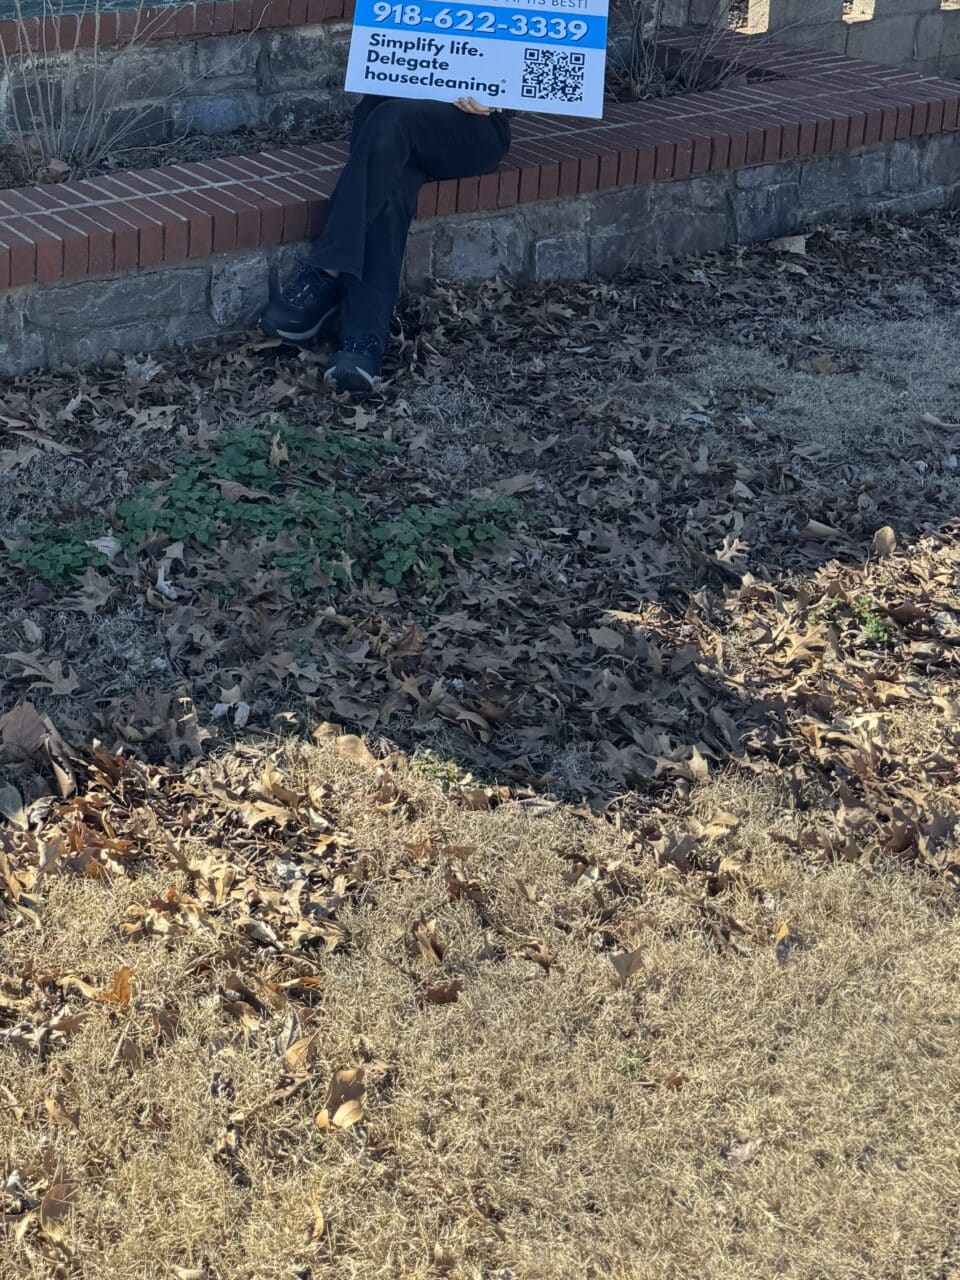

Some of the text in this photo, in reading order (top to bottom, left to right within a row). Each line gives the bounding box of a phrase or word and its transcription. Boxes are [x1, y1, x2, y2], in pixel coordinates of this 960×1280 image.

[372, 1, 589, 42] 918-622-3339
[368, 33, 485, 58] Simplify life.
[366, 49, 450, 72] Delegate
[364, 66, 507, 97] housecleaning.
